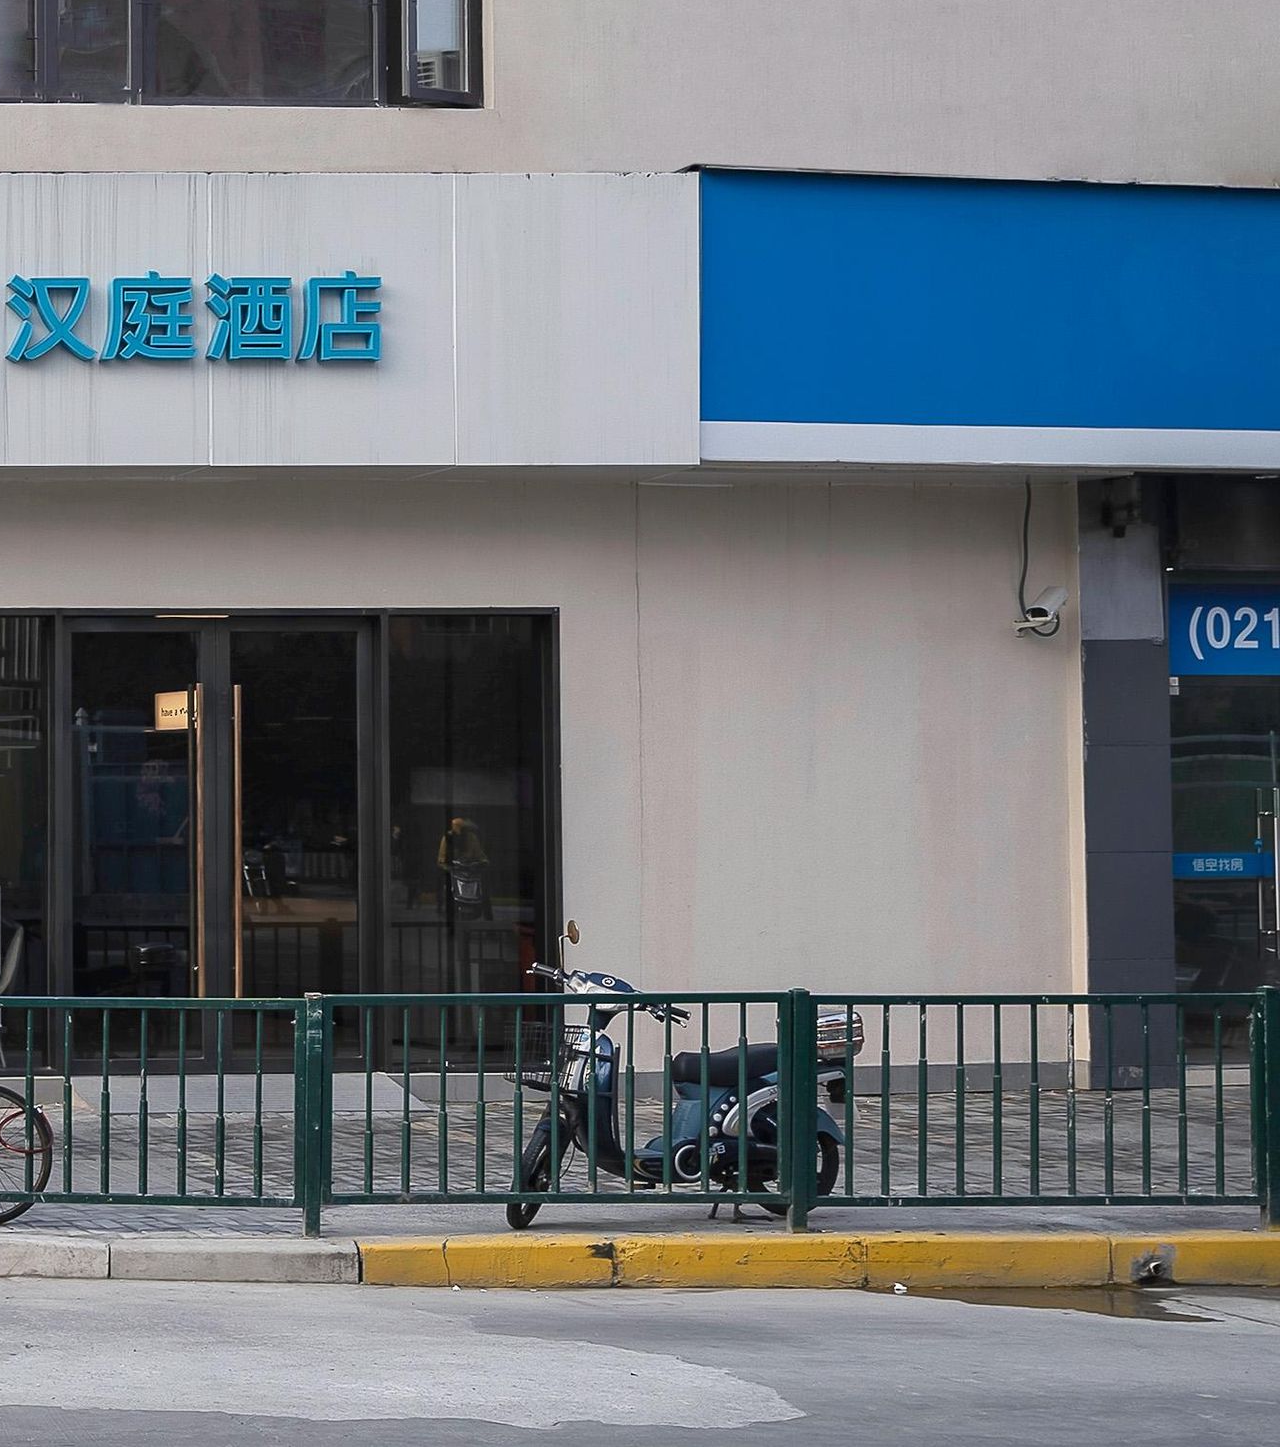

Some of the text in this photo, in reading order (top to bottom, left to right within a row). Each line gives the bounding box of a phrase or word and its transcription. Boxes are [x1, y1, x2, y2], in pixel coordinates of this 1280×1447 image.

[5, 269, 382, 364] 汉庭酒店
[1189, 606, 1280, 660] (021
